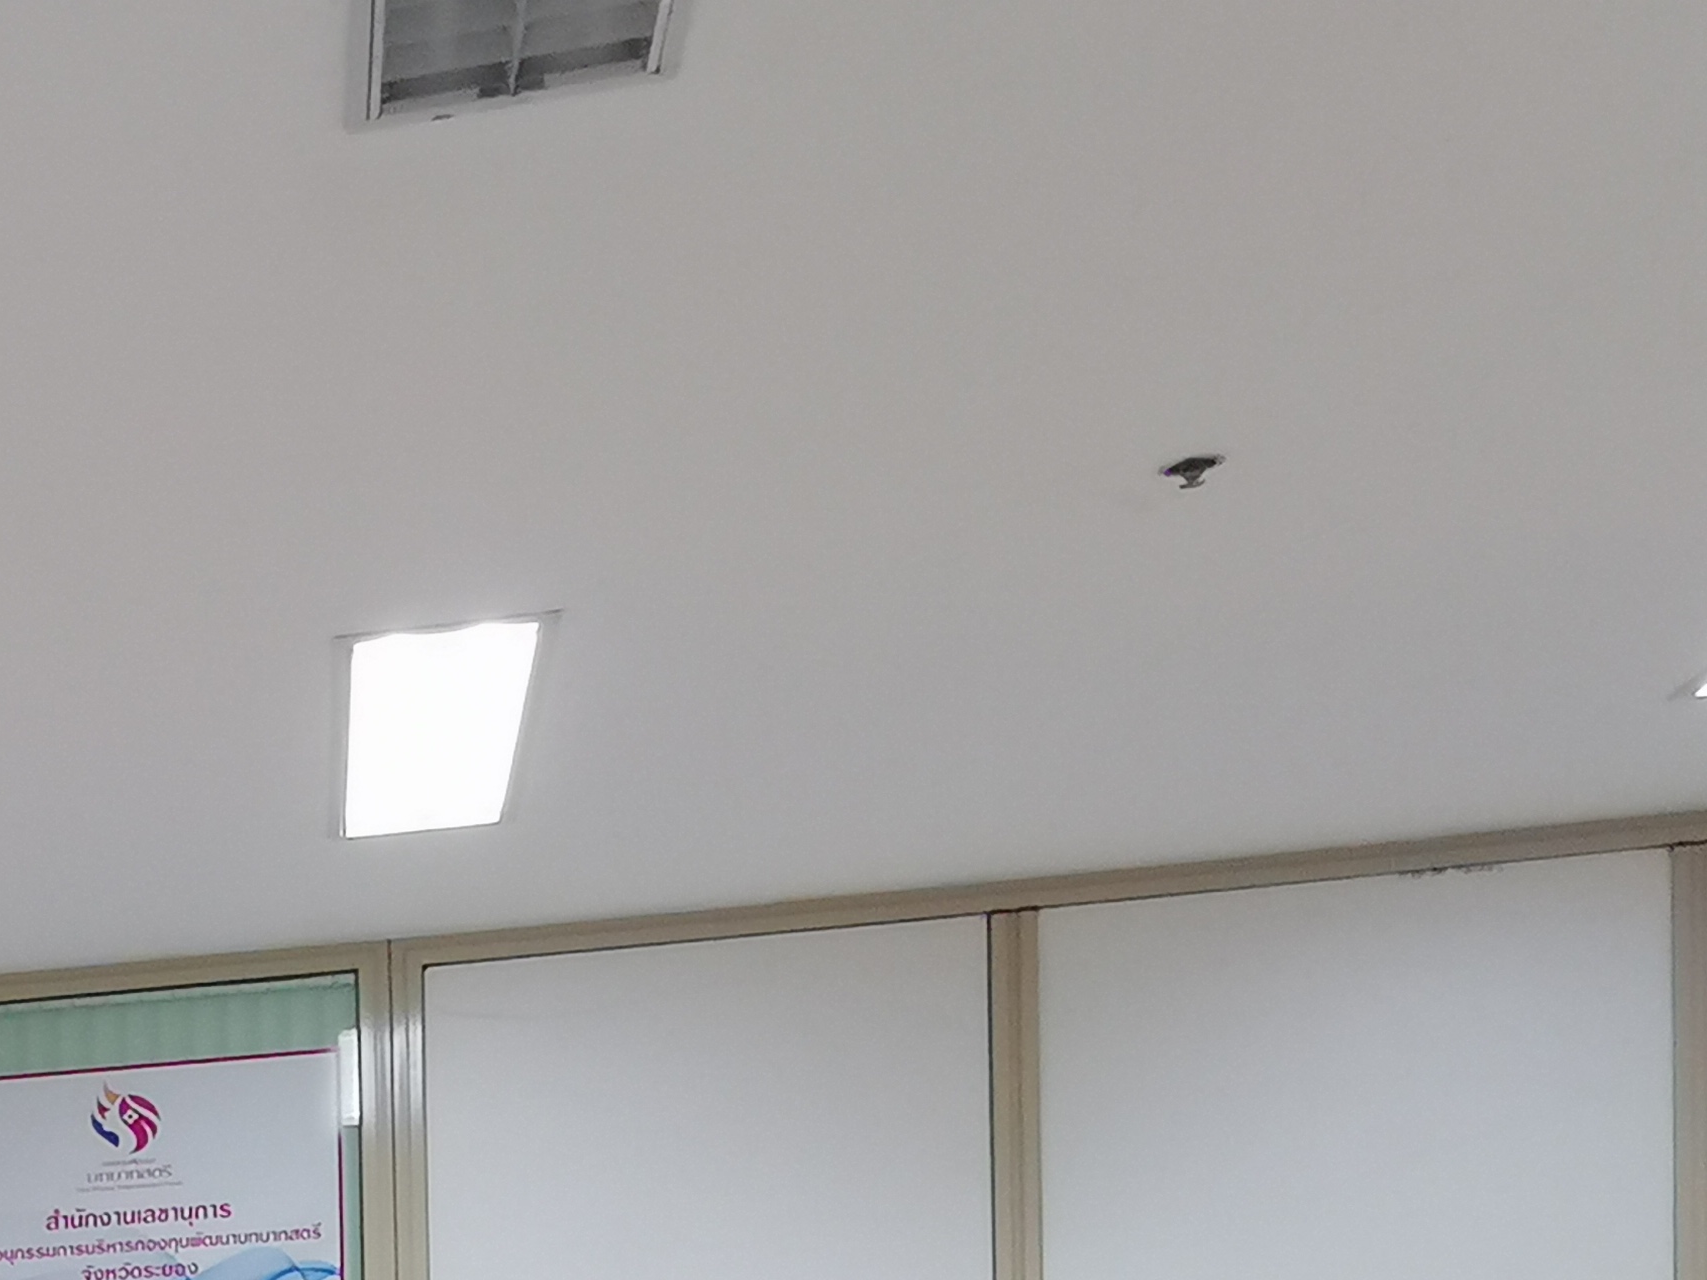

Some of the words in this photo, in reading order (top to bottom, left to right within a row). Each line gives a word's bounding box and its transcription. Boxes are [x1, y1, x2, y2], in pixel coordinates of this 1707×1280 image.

[45, 1202, 232, 1231] สำนักงานเลขานุการ
